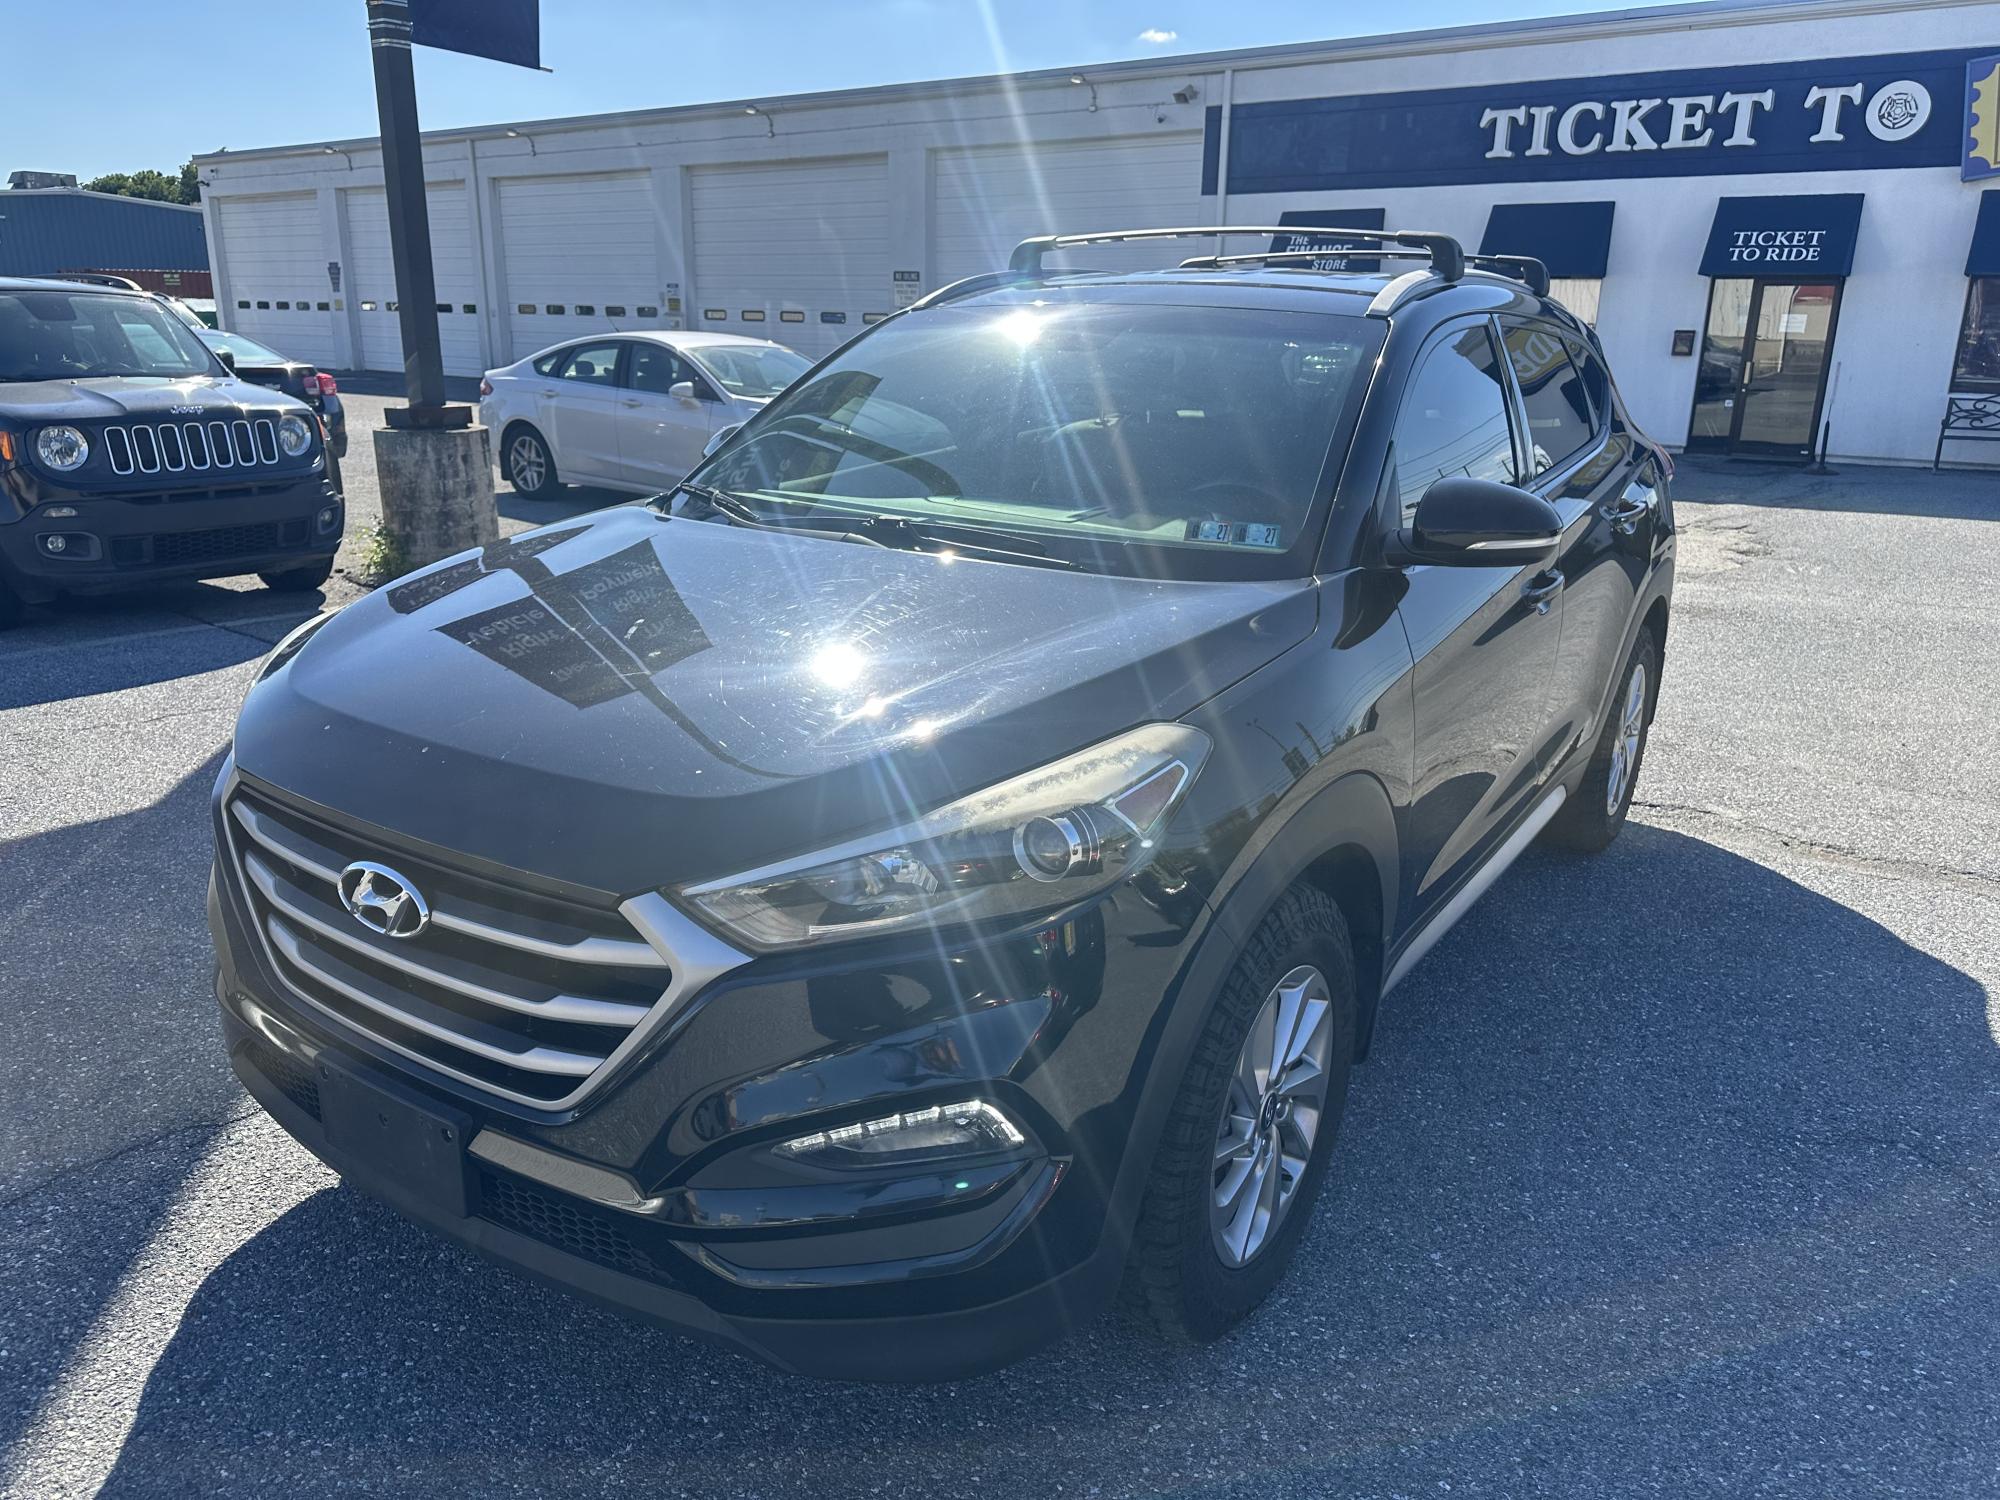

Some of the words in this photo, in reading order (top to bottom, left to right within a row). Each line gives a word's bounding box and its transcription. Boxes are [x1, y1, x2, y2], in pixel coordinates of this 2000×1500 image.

[1479, 89, 1774, 158] TICKET
[1290, 236, 1309, 245] THE
[1733, 230, 1826, 246] TICKET
[1729, 247, 1760, 261] TO
[1764, 247, 1821, 261] RIDE
[1312, 260, 1347, 270] STORE
[1216, 524, 1229, 541] 27
[1264, 527, 1277, 544] 27
